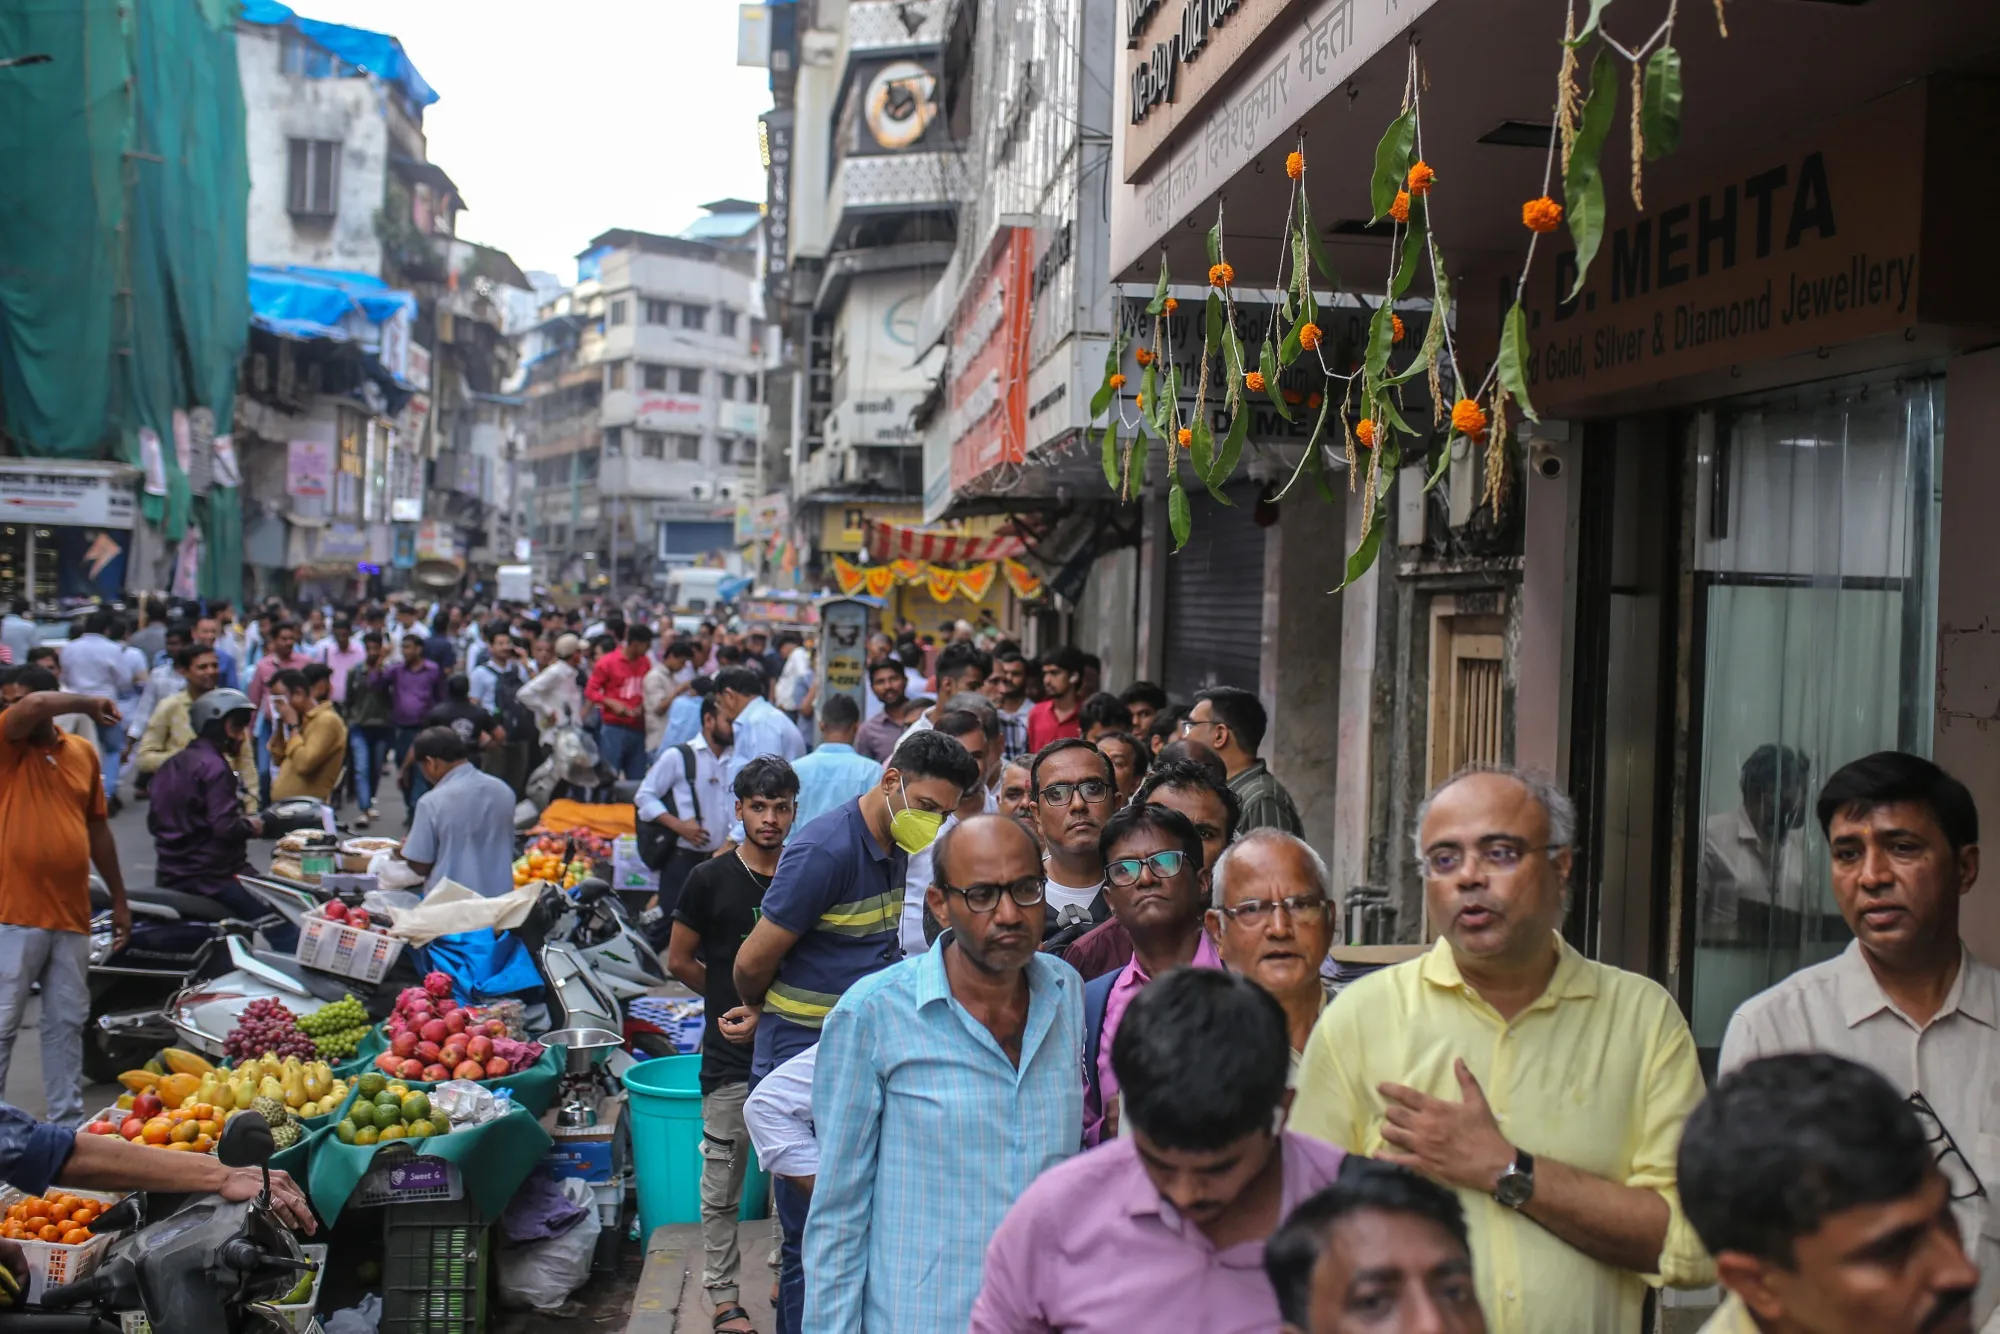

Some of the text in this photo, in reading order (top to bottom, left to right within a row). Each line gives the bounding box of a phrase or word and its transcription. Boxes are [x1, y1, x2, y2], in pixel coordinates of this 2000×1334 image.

[1148, 40, 1175, 105] Buy
[1179, 0, 1203, 62] Old
[1205, 53, 1291, 179] दिनेशकुमार
[1298, 0, 1354, 82] मेहता
[1611, 150, 1836, 304] MEHTA
[1121, 304, 1147, 338] We
[1545, 333, 1587, 382] Gold,
[1594, 324, 1646, 369] Silver
[1652, 312, 1665, 357] &
[1674, 280, 1772, 350] Diamond
[1781, 254, 1915, 326] Jewellery
[409, 1172, 432, 1181] Sweet
